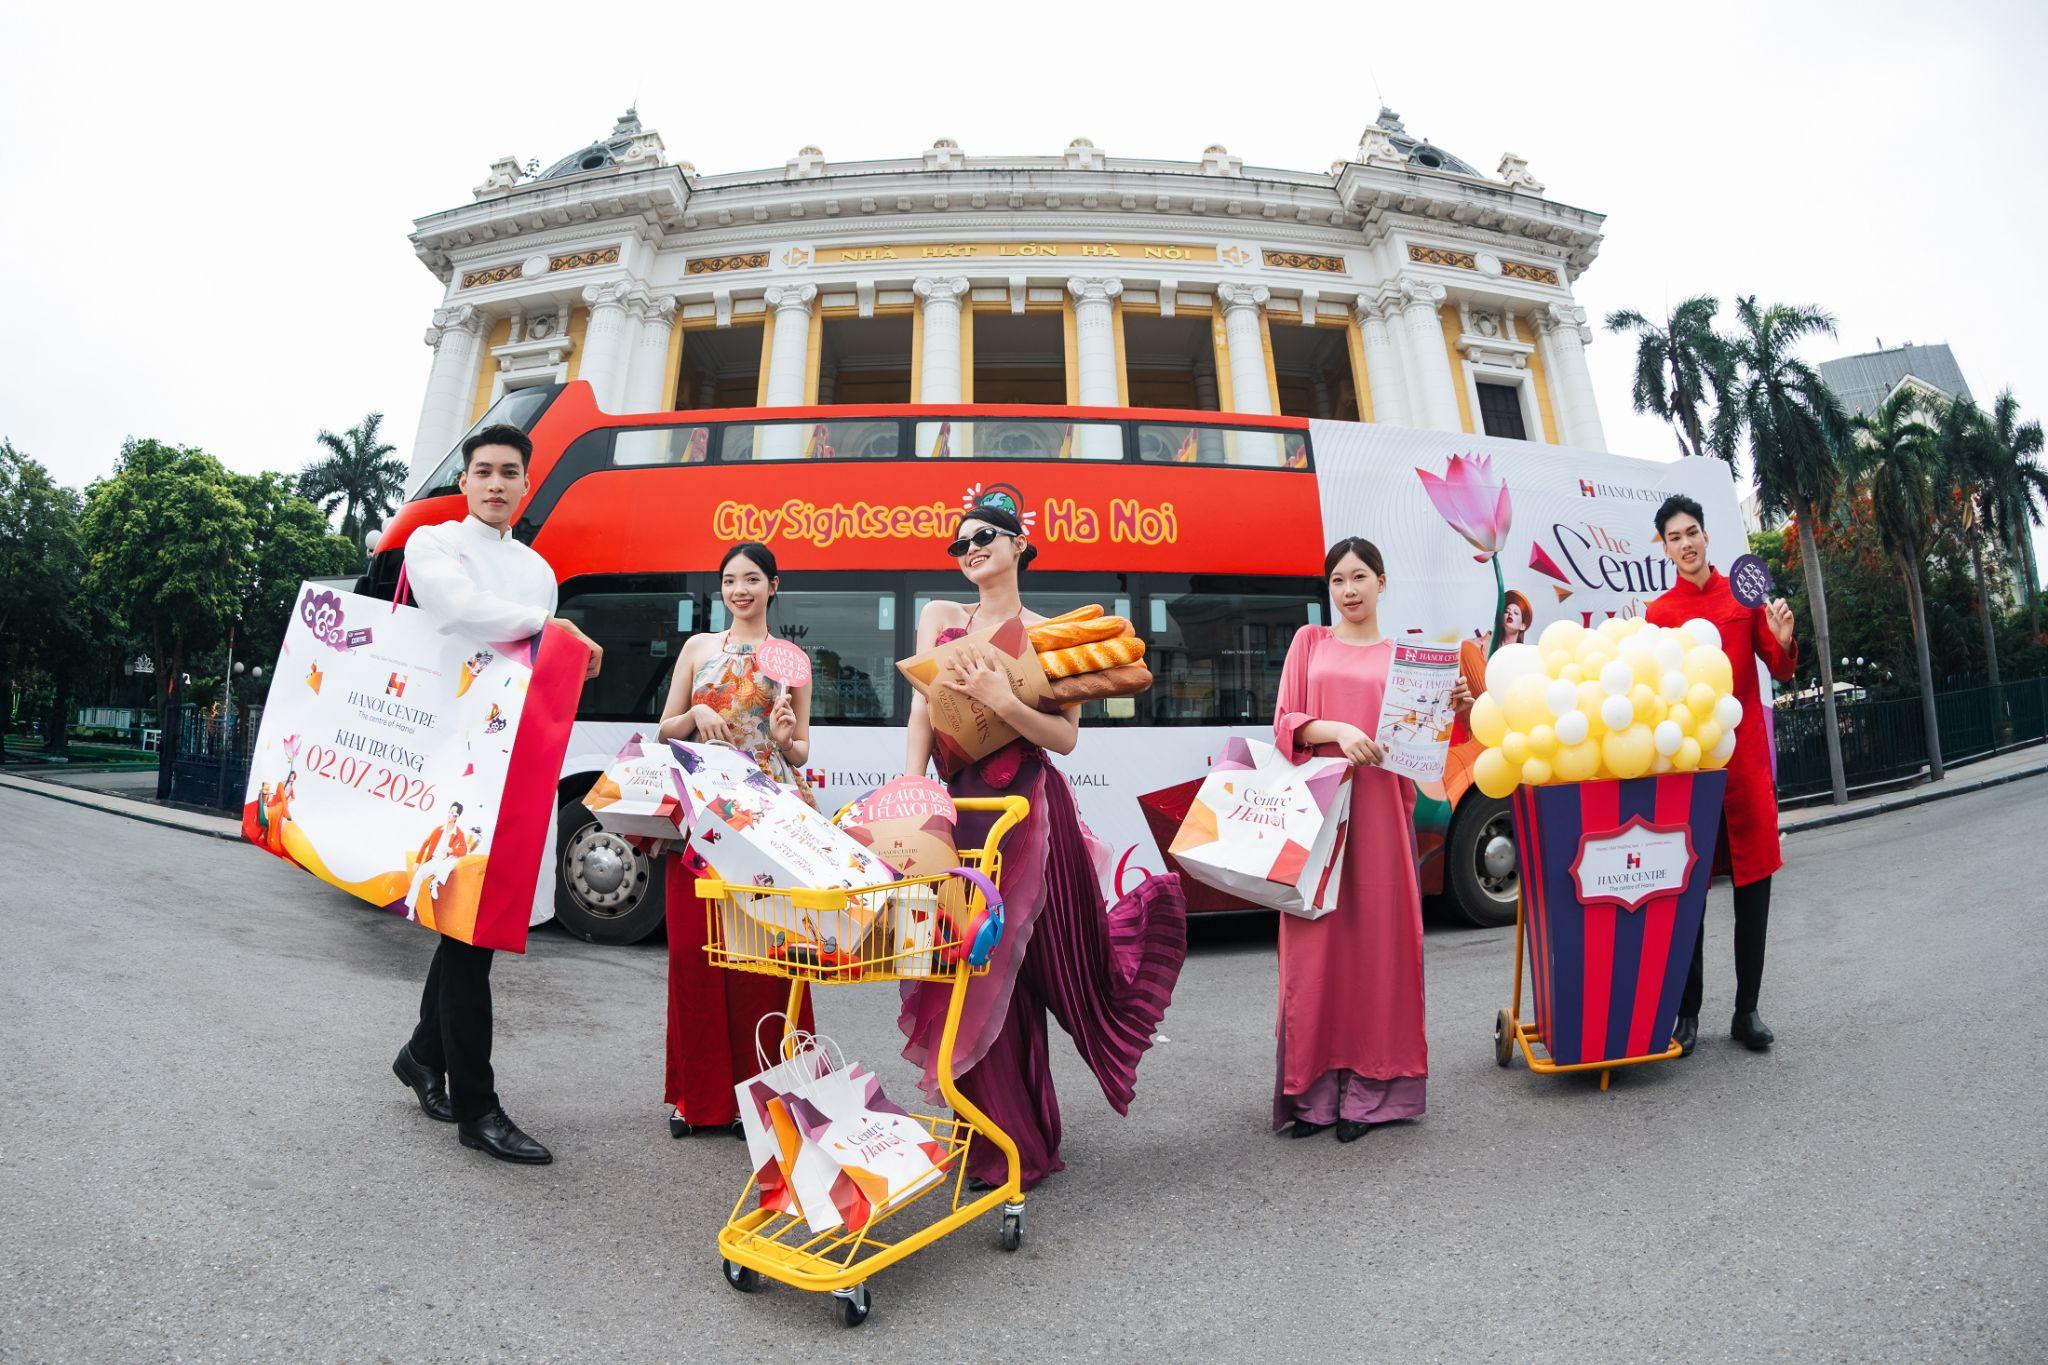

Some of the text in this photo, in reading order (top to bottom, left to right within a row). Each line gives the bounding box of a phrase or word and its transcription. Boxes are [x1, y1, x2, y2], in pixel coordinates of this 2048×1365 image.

[840, 245, 898, 262] NHÀ
[921, 243, 977, 258] HÁT
[999, 243, 1057, 256] LỚN
[1081, 243, 1120, 257] HÀ
[1598, 483, 1634, 500] HANOI
[713, 498, 1178, 547] CitySightseein Ha Noi
[1580, 522, 1631, 554] The
[1553, 523, 1675, 593] Centr
[1419, 652, 1443, 662] HANOI
[348, 691, 438, 729] HANOI CENTRE
[359, 710, 368, 720] The
[369, 714, 387, 726] centre
[396, 721, 415, 734] Hanoi
[335, 728, 366, 752] KHAI
[306, 744, 436, 812] 02.07.2026
[832, 772, 886, 787] HANOI
[1069, 774, 1110, 787] MALL
[879, 787, 949, 807] FLAVOURS
[1244, 788, 1291, 806] Centre
[877, 802, 952, 818] FLAVOURS
[1227, 805, 1286, 830] Hanoi
[1597, 869, 1667, 885] HANOI CENTRE
[847, 1121, 884, 1145] Centre
[861, 1132, 906, 1164] Hanoi
